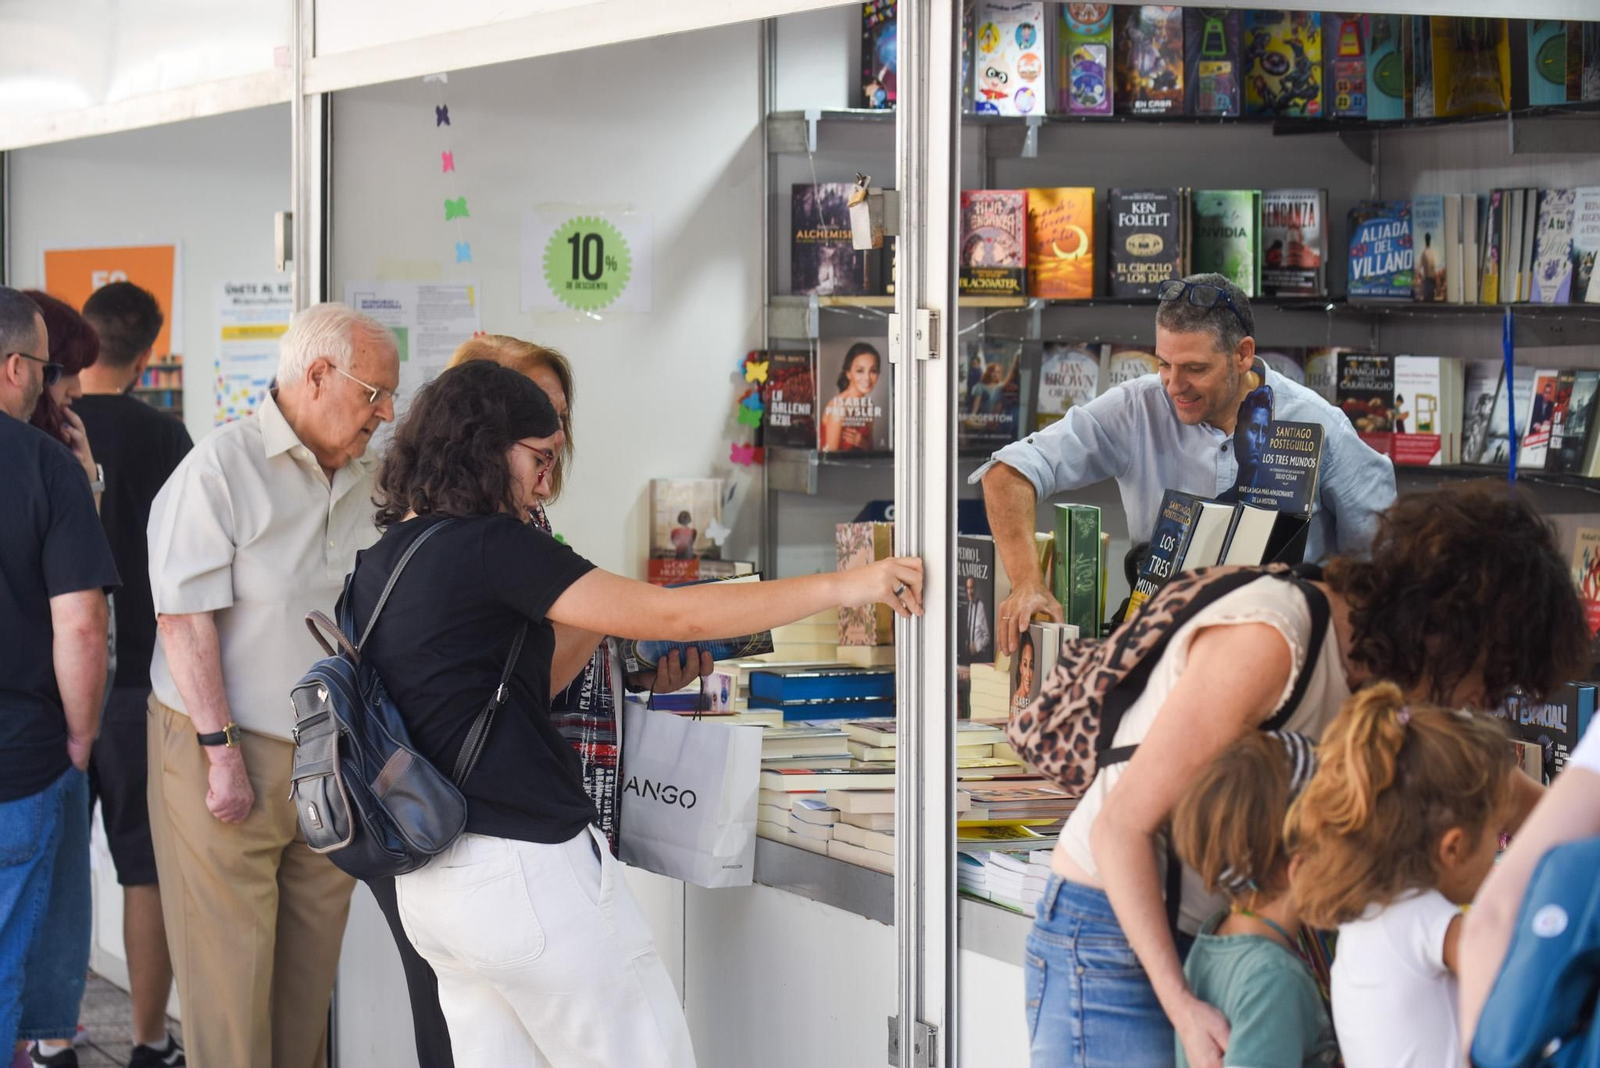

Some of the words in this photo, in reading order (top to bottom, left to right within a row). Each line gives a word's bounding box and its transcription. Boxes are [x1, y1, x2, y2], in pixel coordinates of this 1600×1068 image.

[1132, 202, 1156, 214] KEN
[1263, 202, 1316, 227] VENGANZA
[1119, 213, 1170, 227] FOLLETT
[1361, 221, 1409, 244] ALIADA
[1374, 240, 1393, 254] DEL
[567, 231, 618, 281] 10%
[1117, 263, 1127, 273] EL
[1352, 249, 1413, 280] VILLANO
[959, 278, 1020, 291] BLACKWATER
[1127, 273, 1145, 283] LOS
[1060, 361, 1083, 373] DAN
[1045, 372, 1094, 387] BROWN
[833, 396, 874, 407] ISABEL
[825, 406, 882, 417] PREYSLER
[1276, 426, 1312, 439] SANTIAGO
[1269, 438, 1315, 452] POSTEGUILLO
[1262, 453, 1276, 464] LOS
[1275, 454, 1289, 465] TRES
[1289, 457, 1316, 468] MUNDOS
[1169, 501, 1191, 514] SANTIAGO
[1159, 534, 1175, 552] LOS
[1149, 555, 1170, 578] TRES
[624, 776, 697, 809] ANGO
